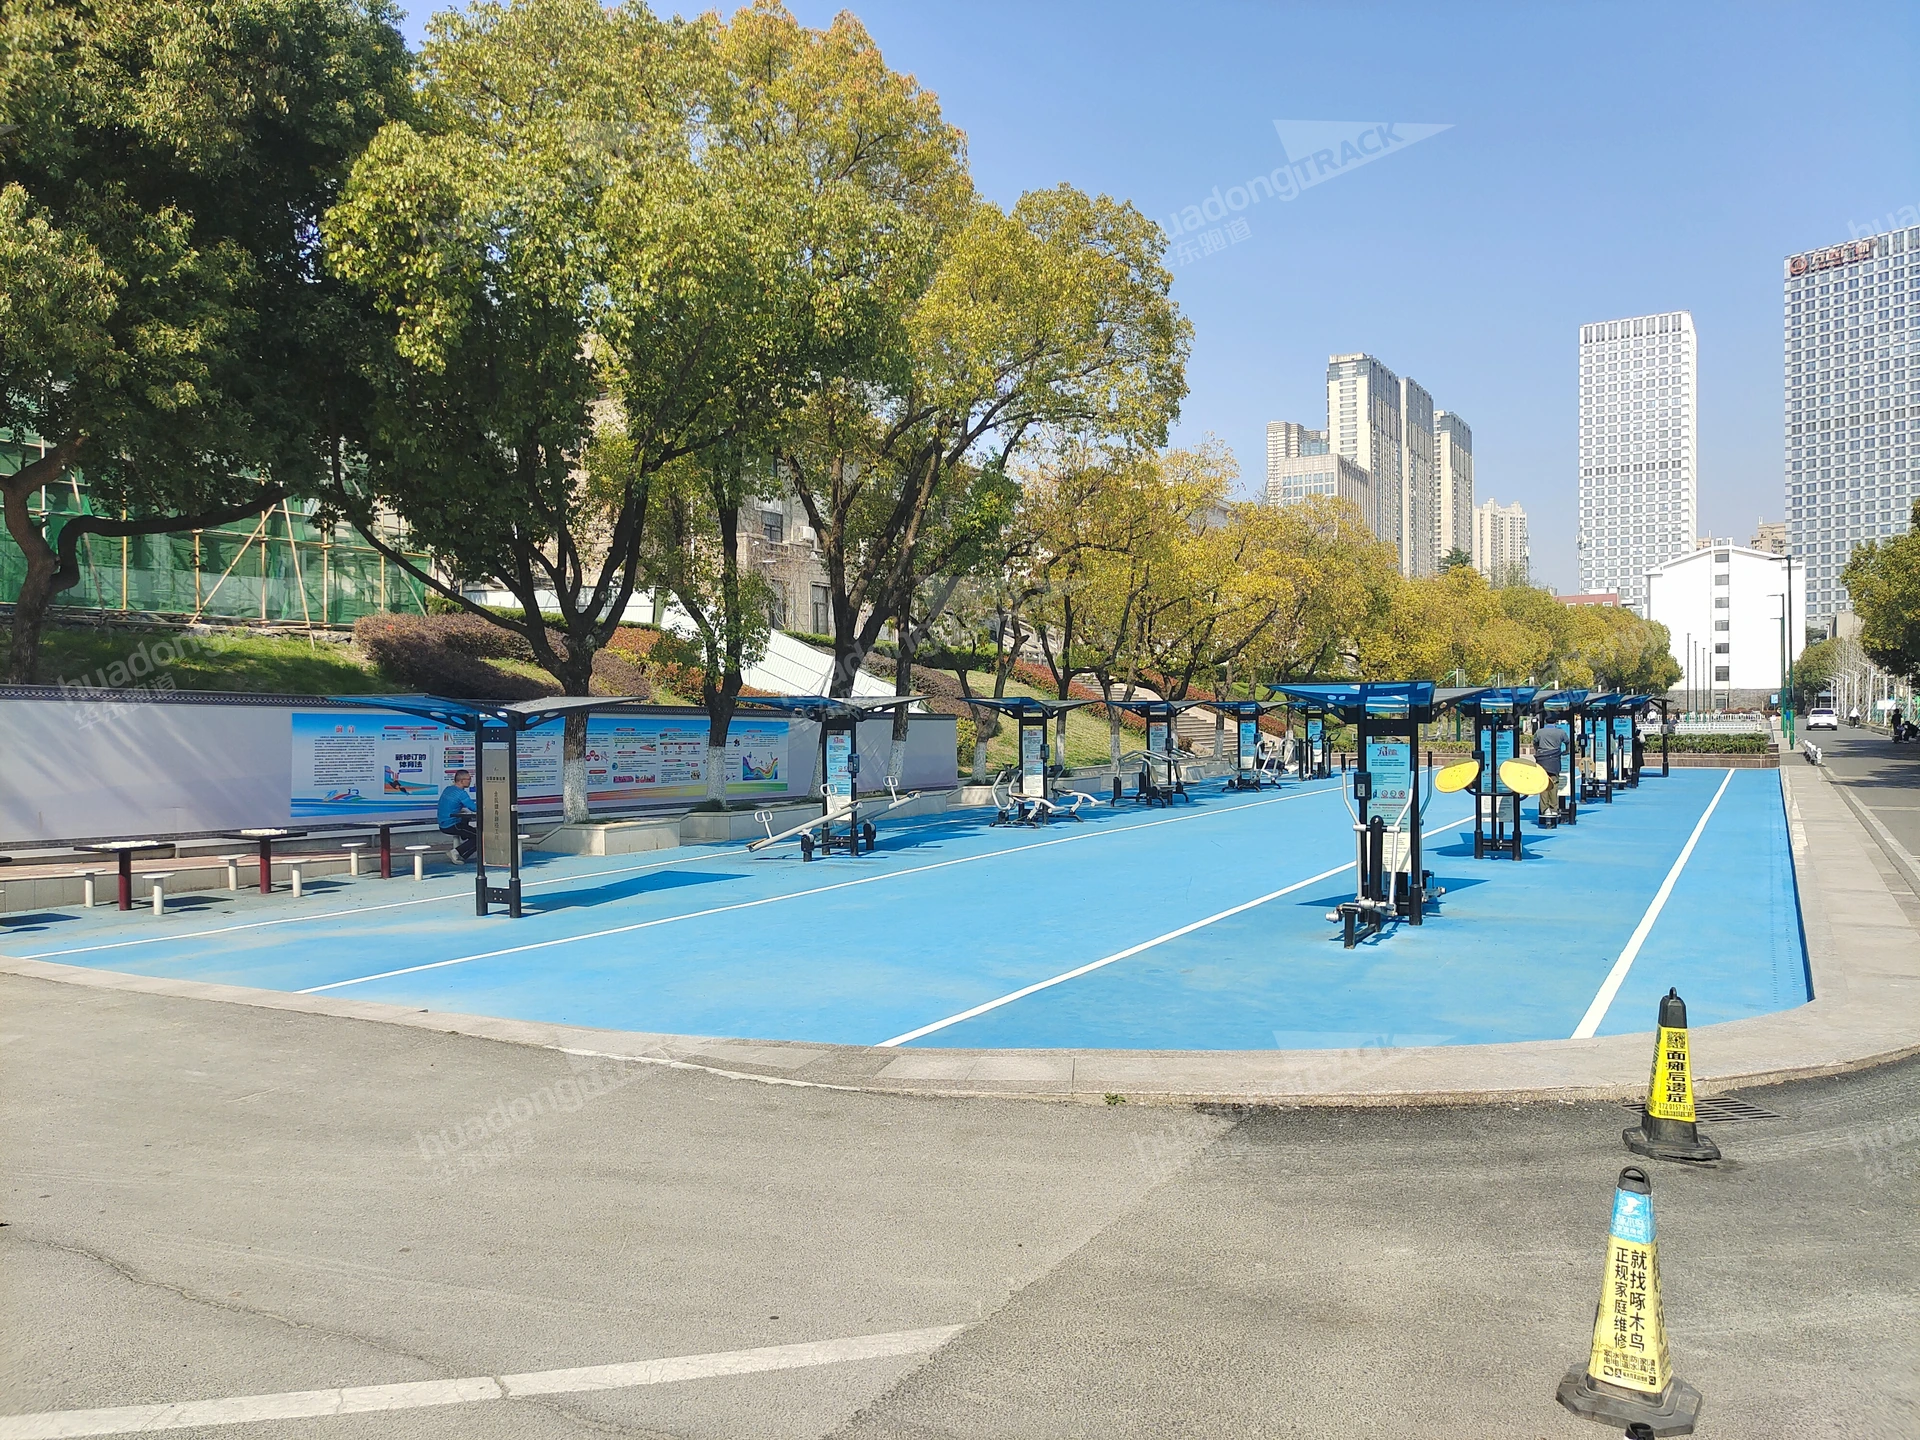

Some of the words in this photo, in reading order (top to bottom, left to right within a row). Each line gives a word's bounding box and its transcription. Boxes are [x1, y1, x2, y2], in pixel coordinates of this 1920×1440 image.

[395, 753, 427, 761] 新修订的
[1665, 1050, 1687, 1103] 面瘫后遗症
[1613, 1246, 1629, 1350] 正规家庭维修
[1629, 1250, 1647, 1352] 就找啄木鸟
